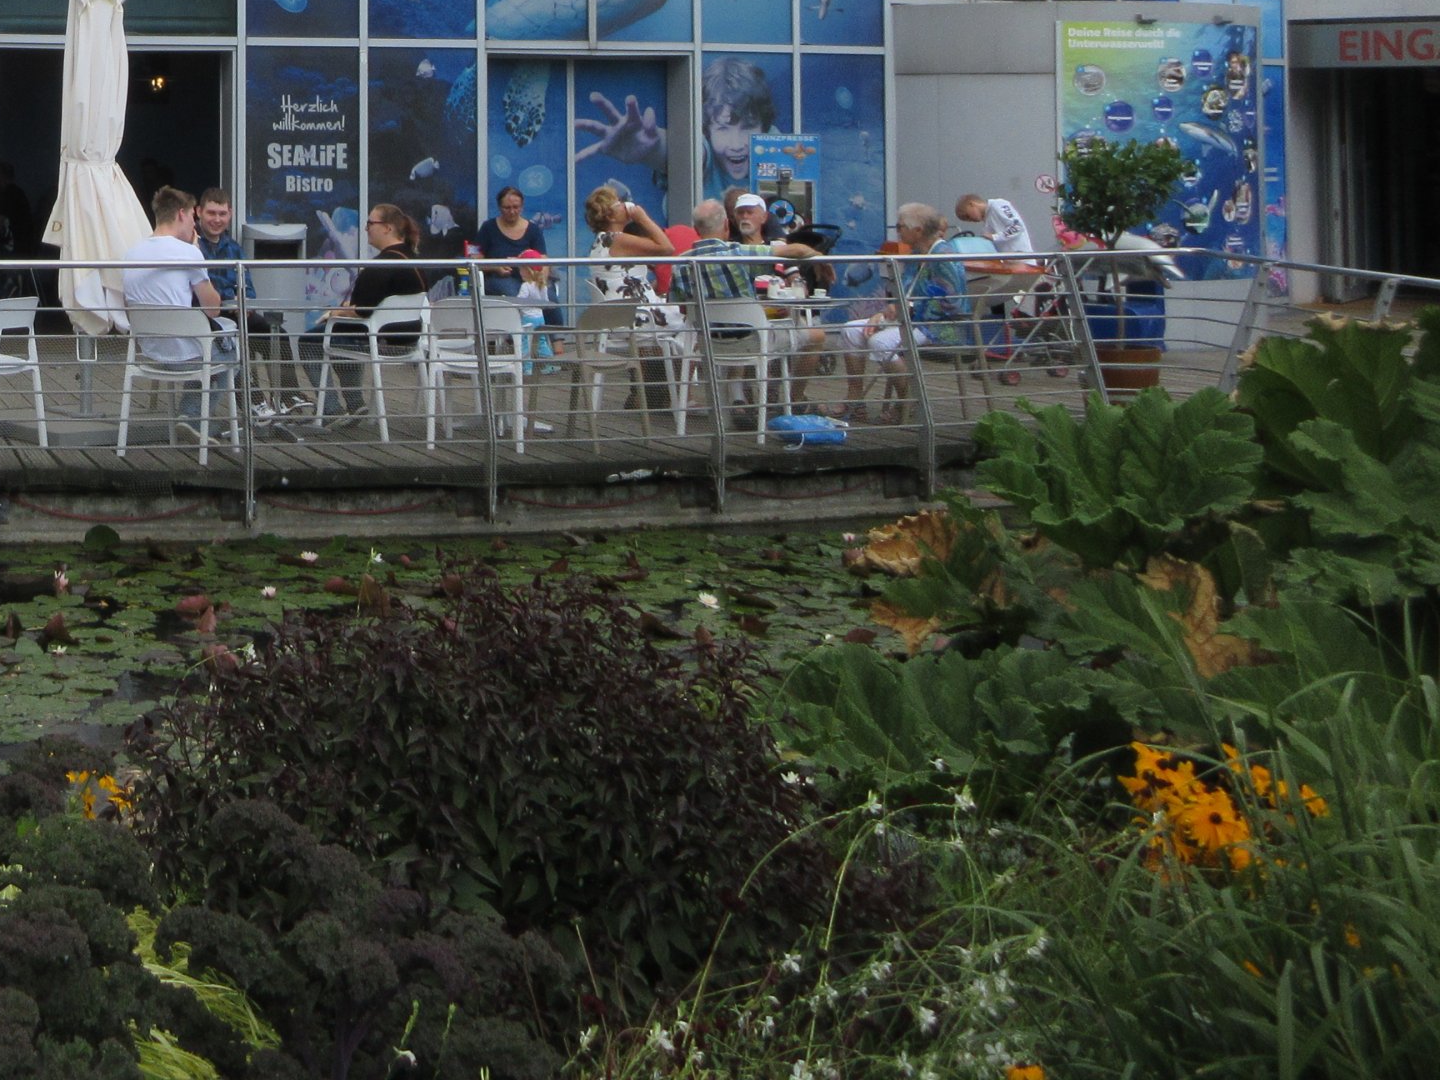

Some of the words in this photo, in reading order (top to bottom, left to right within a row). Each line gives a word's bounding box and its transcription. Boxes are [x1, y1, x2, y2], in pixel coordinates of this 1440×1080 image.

[1067, 28, 1101, 38] Deine
[1103, 28, 1133, 38] Reise
[1135, 28, 1164, 38] durch
[1338, 28, 1440, 61] EING
[280, 94, 338, 114] Herzlich
[272, 115, 345, 132] willkommen!
[285, 175, 333, 192] Bistro
